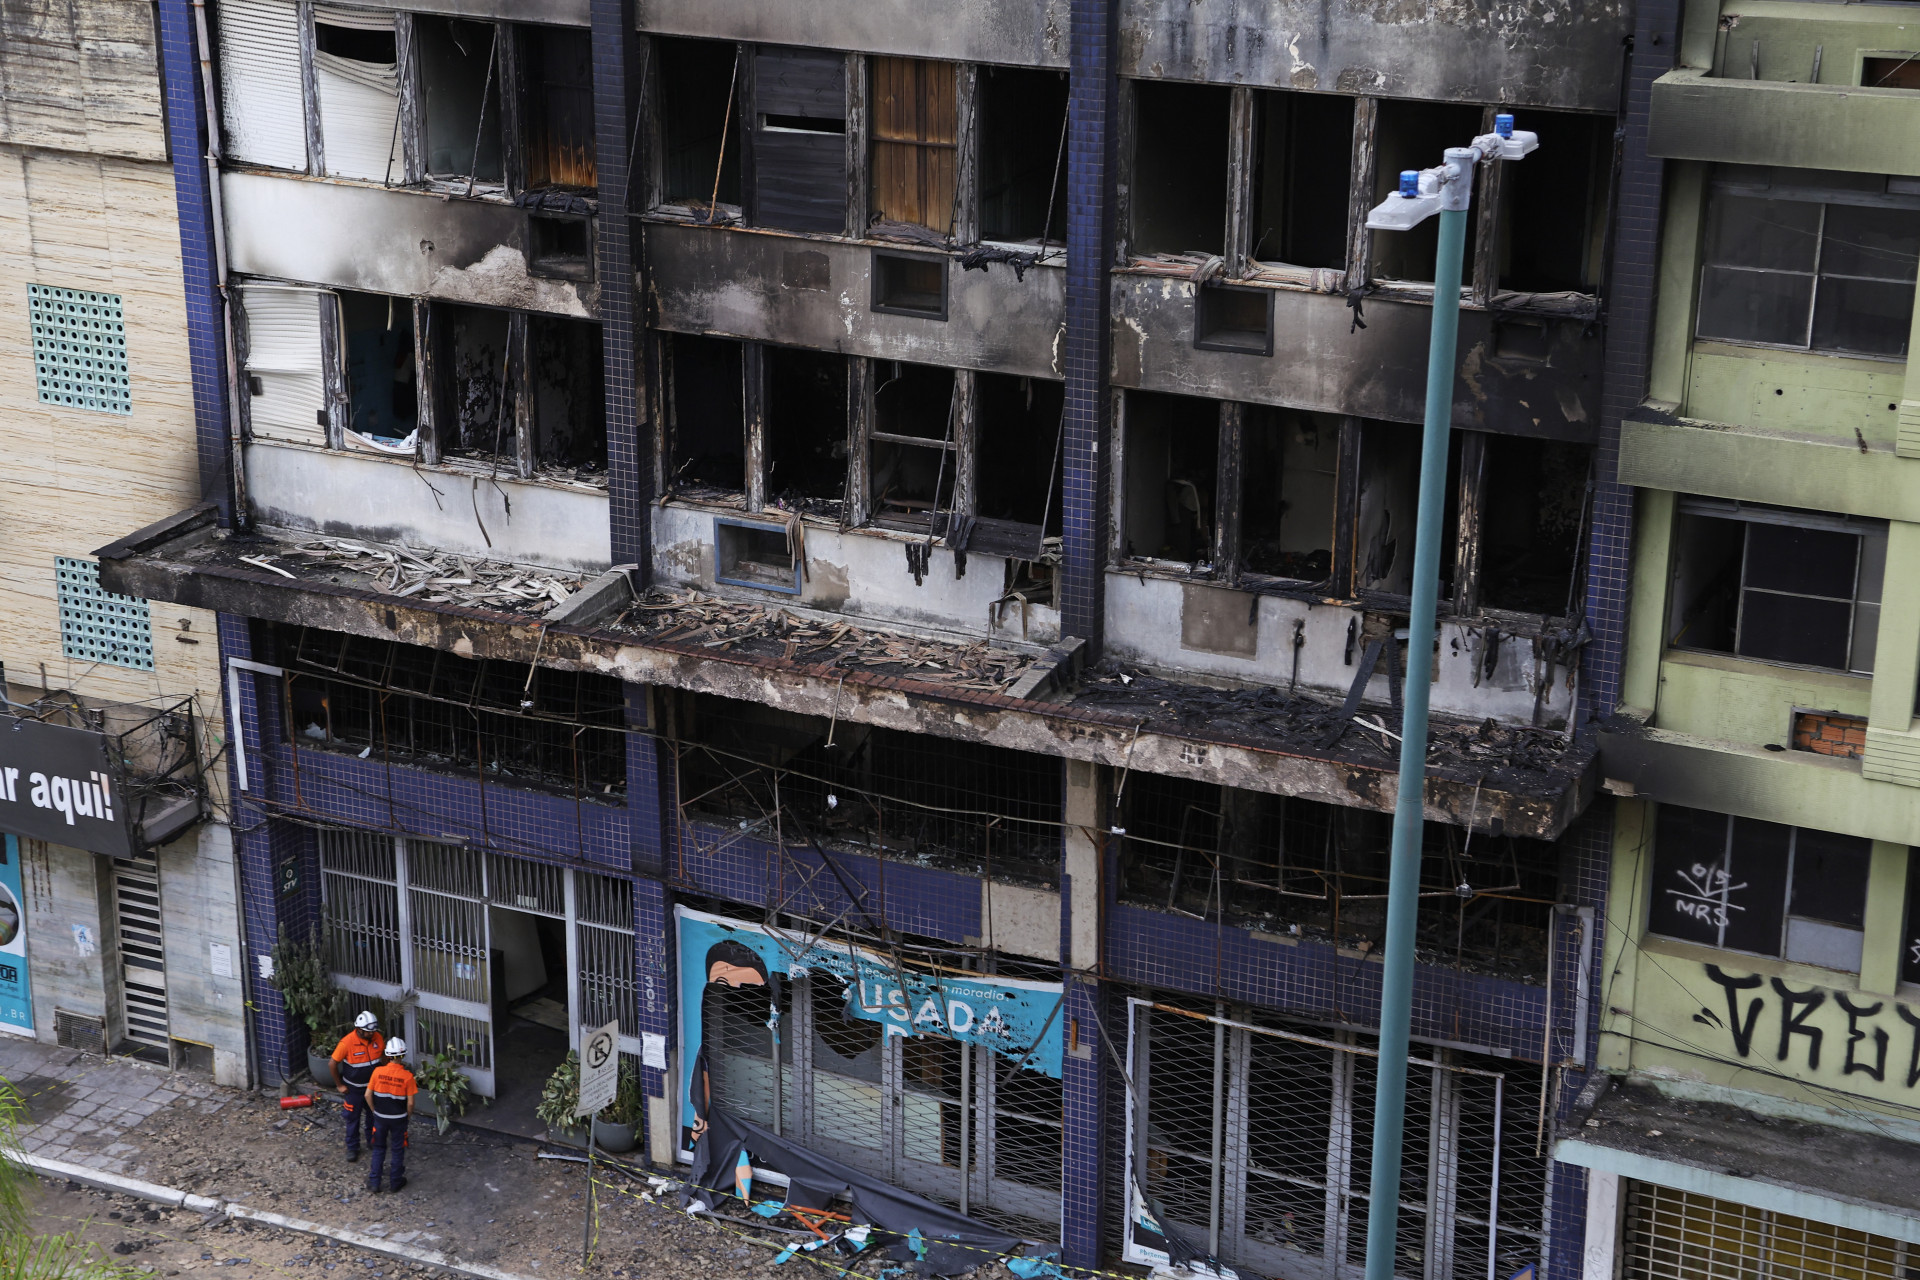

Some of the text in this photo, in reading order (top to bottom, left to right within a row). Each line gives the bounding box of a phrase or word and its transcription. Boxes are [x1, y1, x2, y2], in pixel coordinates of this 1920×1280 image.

[29, 770, 115, 826] aqui!
[1676, 899, 1730, 927] MRS
[644, 975, 656, 1013] 305
